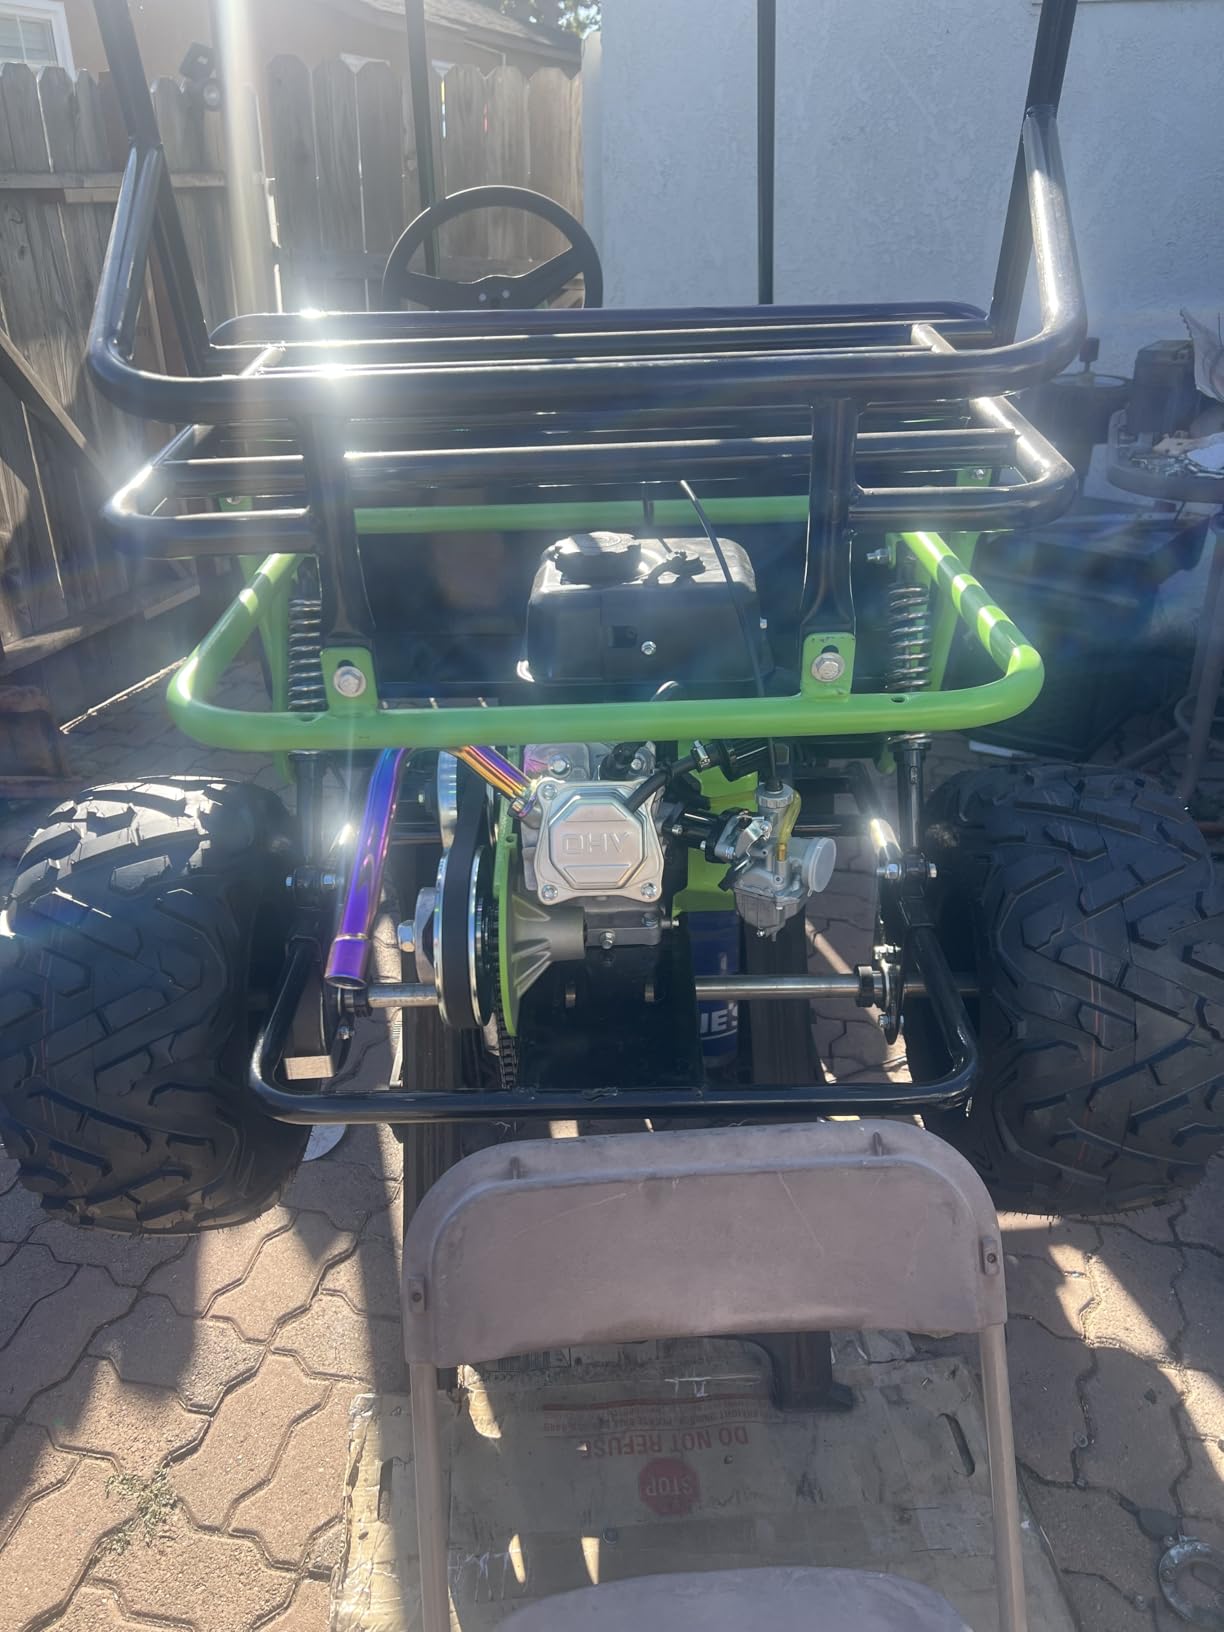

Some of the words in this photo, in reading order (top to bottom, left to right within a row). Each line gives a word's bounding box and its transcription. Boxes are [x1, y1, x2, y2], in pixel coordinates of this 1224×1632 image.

[561, 832, 632, 855] OHV
[671, 1430, 712, 1451] NOT
[718, 1426, 749, 1446] DO
[646, 1474, 693, 1496] STOP
